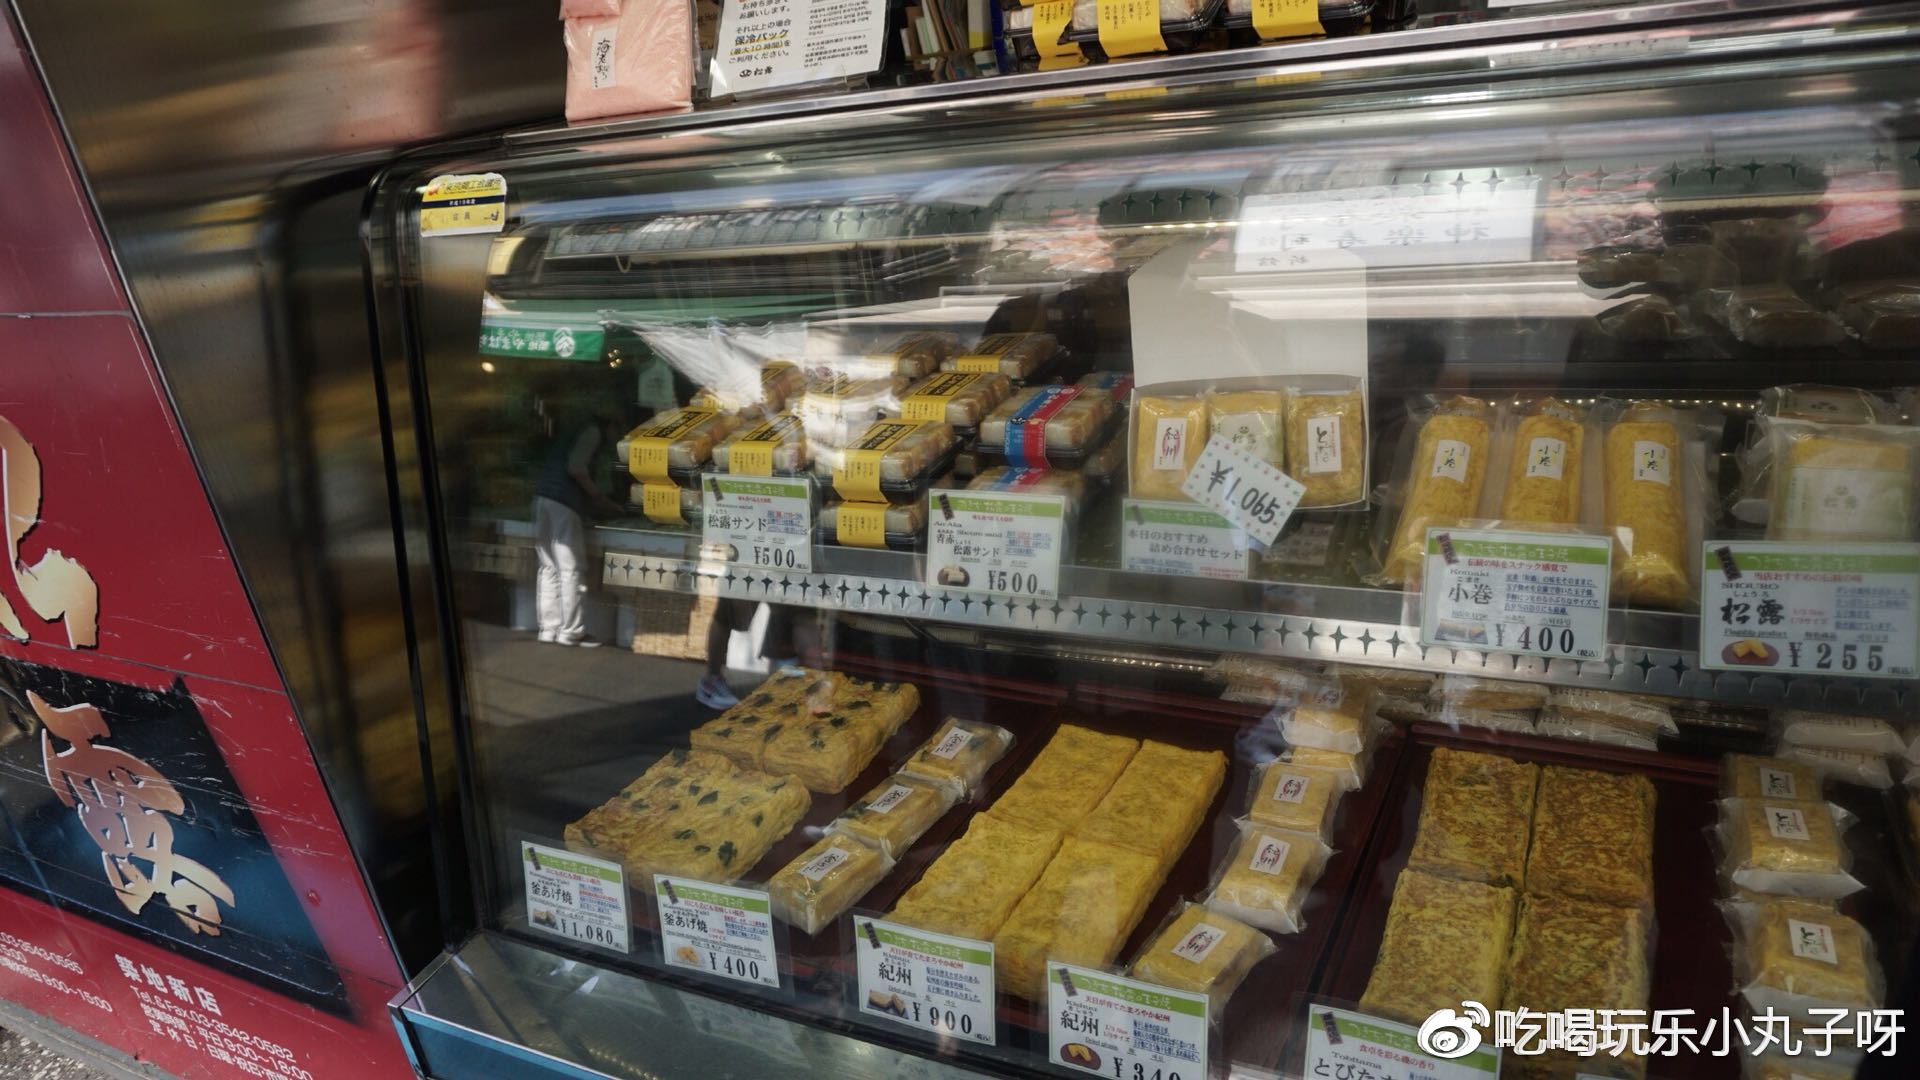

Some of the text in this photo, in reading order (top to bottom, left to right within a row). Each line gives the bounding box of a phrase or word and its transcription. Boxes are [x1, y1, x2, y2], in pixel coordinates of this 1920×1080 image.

[735, 29, 789, 46] 保冷パック
[737, 18, 791, 34] それ以上の場合
[729, 50, 790, 64] ご利用ください。
[707, 514, 768, 532] 松露サンド
[1128, 528, 1209, 545] 本日のおすすめ
[754, 546, 796, 569] ¥500
[953, 545, 1000, 557] 松露サンド
[1149, 543, 1243, 560] 詰め合わせセット
[988, 569, 1038, 594] ¥500
[1448, 583, 1494, 605] 小巻
[1720, 598, 1785, 626] 松露
[1496, 623, 1575, 654] ¥400
[1789, 642, 1884, 672] ¥255
[531, 881, 573, 905] 釜あげ焼
[561, 919, 613, 945] ¥1,080
[664, 912, 708, 933] 釜あげ焼
[709, 952, 759, 979] ¥400
[879, 962, 912, 986] 紀州
[114, 953, 222, 1017] 築地新店
[913, 1002, 972, 1034] ¥900
[1060, 1010, 1099, 1036] 紀州
[1314, 1058, 1397, 1080] とびた
[1360, 1044, 1435, 1071] 食卓を彩る磯の香り
